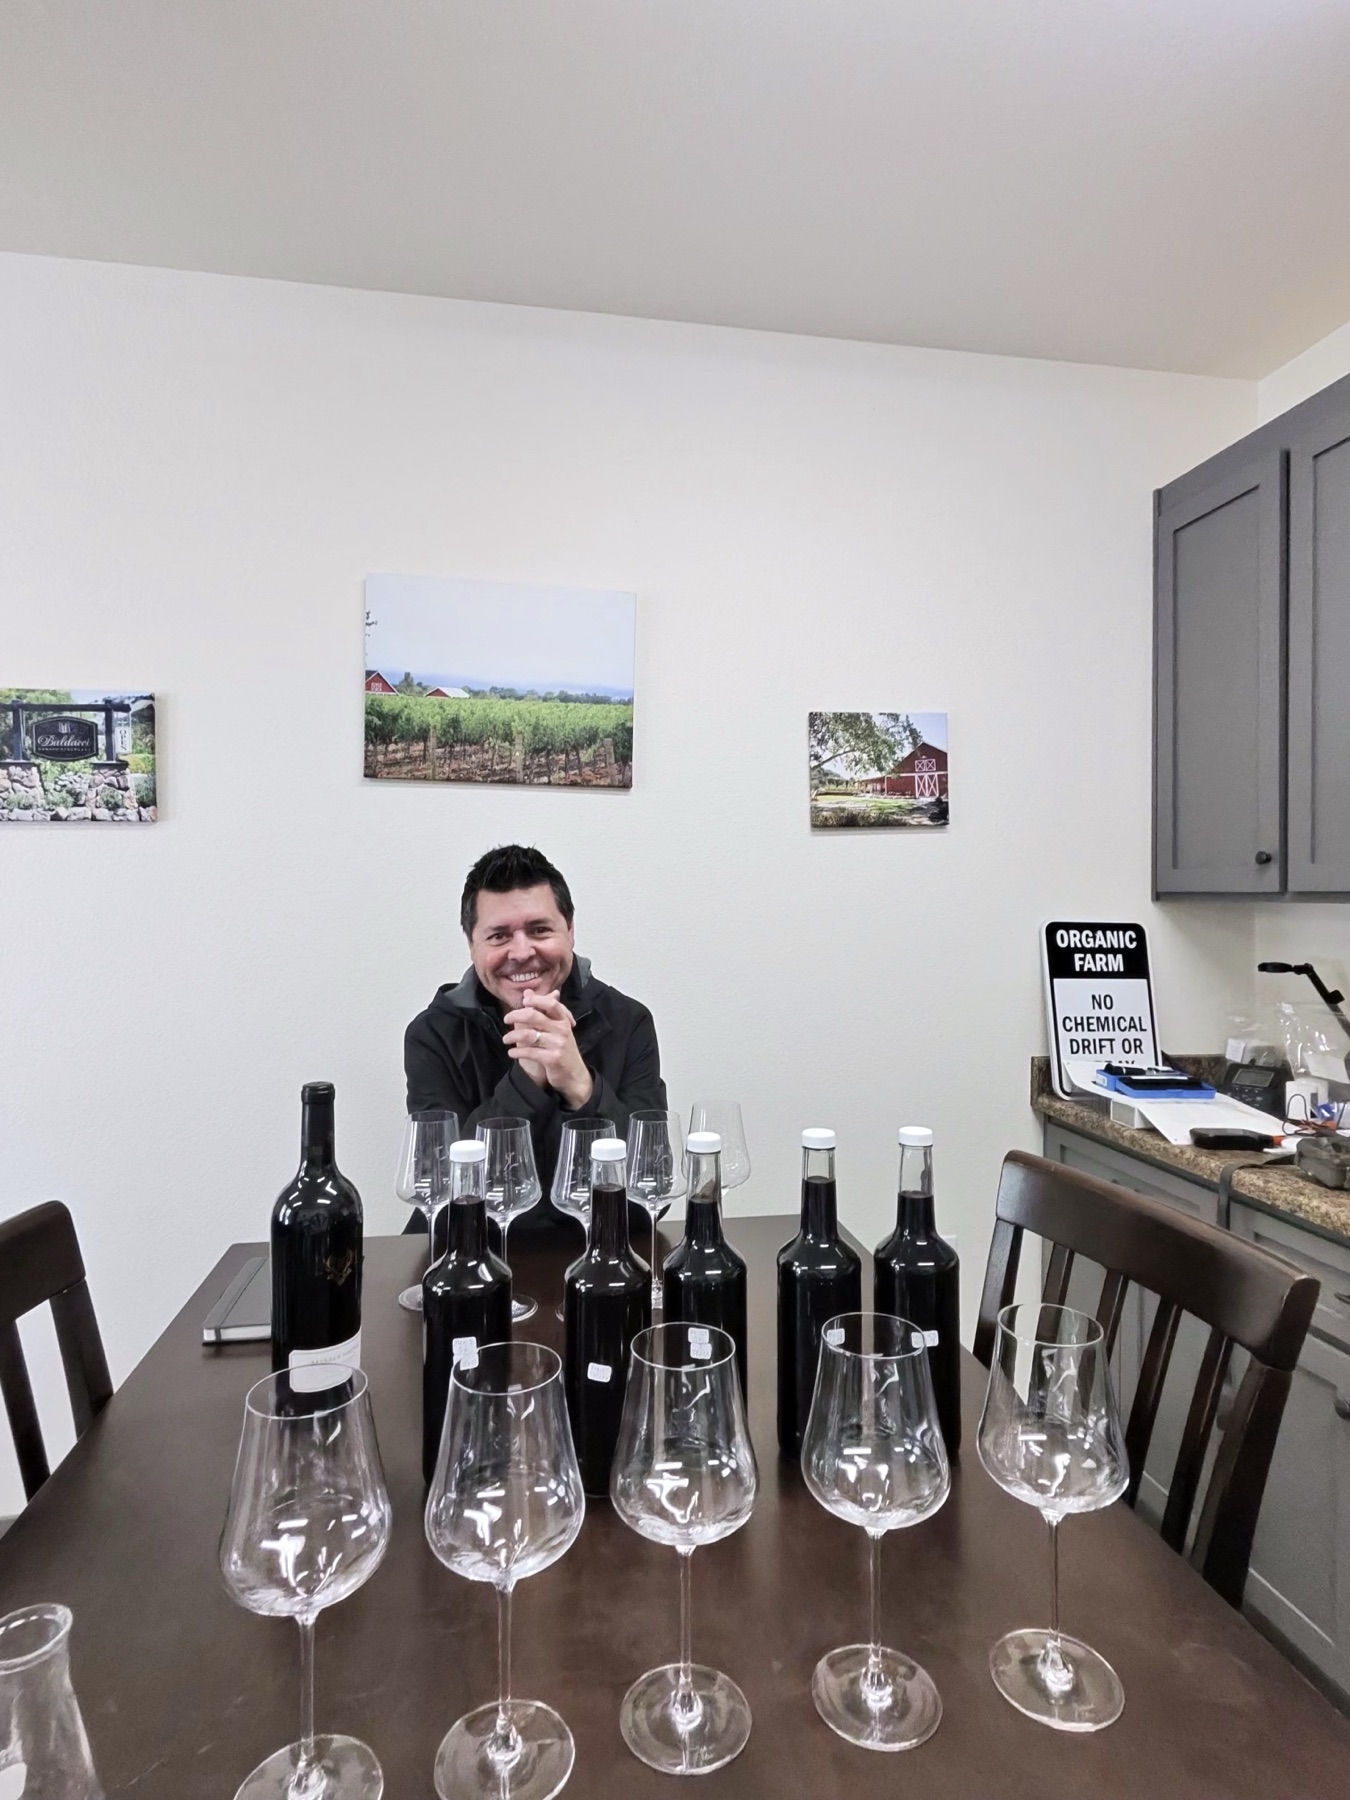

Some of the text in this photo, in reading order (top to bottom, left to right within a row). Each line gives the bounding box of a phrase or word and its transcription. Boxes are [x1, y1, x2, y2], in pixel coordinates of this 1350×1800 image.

[37, 735, 90, 747] Baldacci
[1056, 929, 1137, 949] ORGANIC
[1074, 953, 1124, 972] FARM
[1091, 994, 1114, 1010] NO
[1062, 1016, 1147, 1032] CHEMICAL
[1069, 1038, 1144, 1055] DRIFT OR
